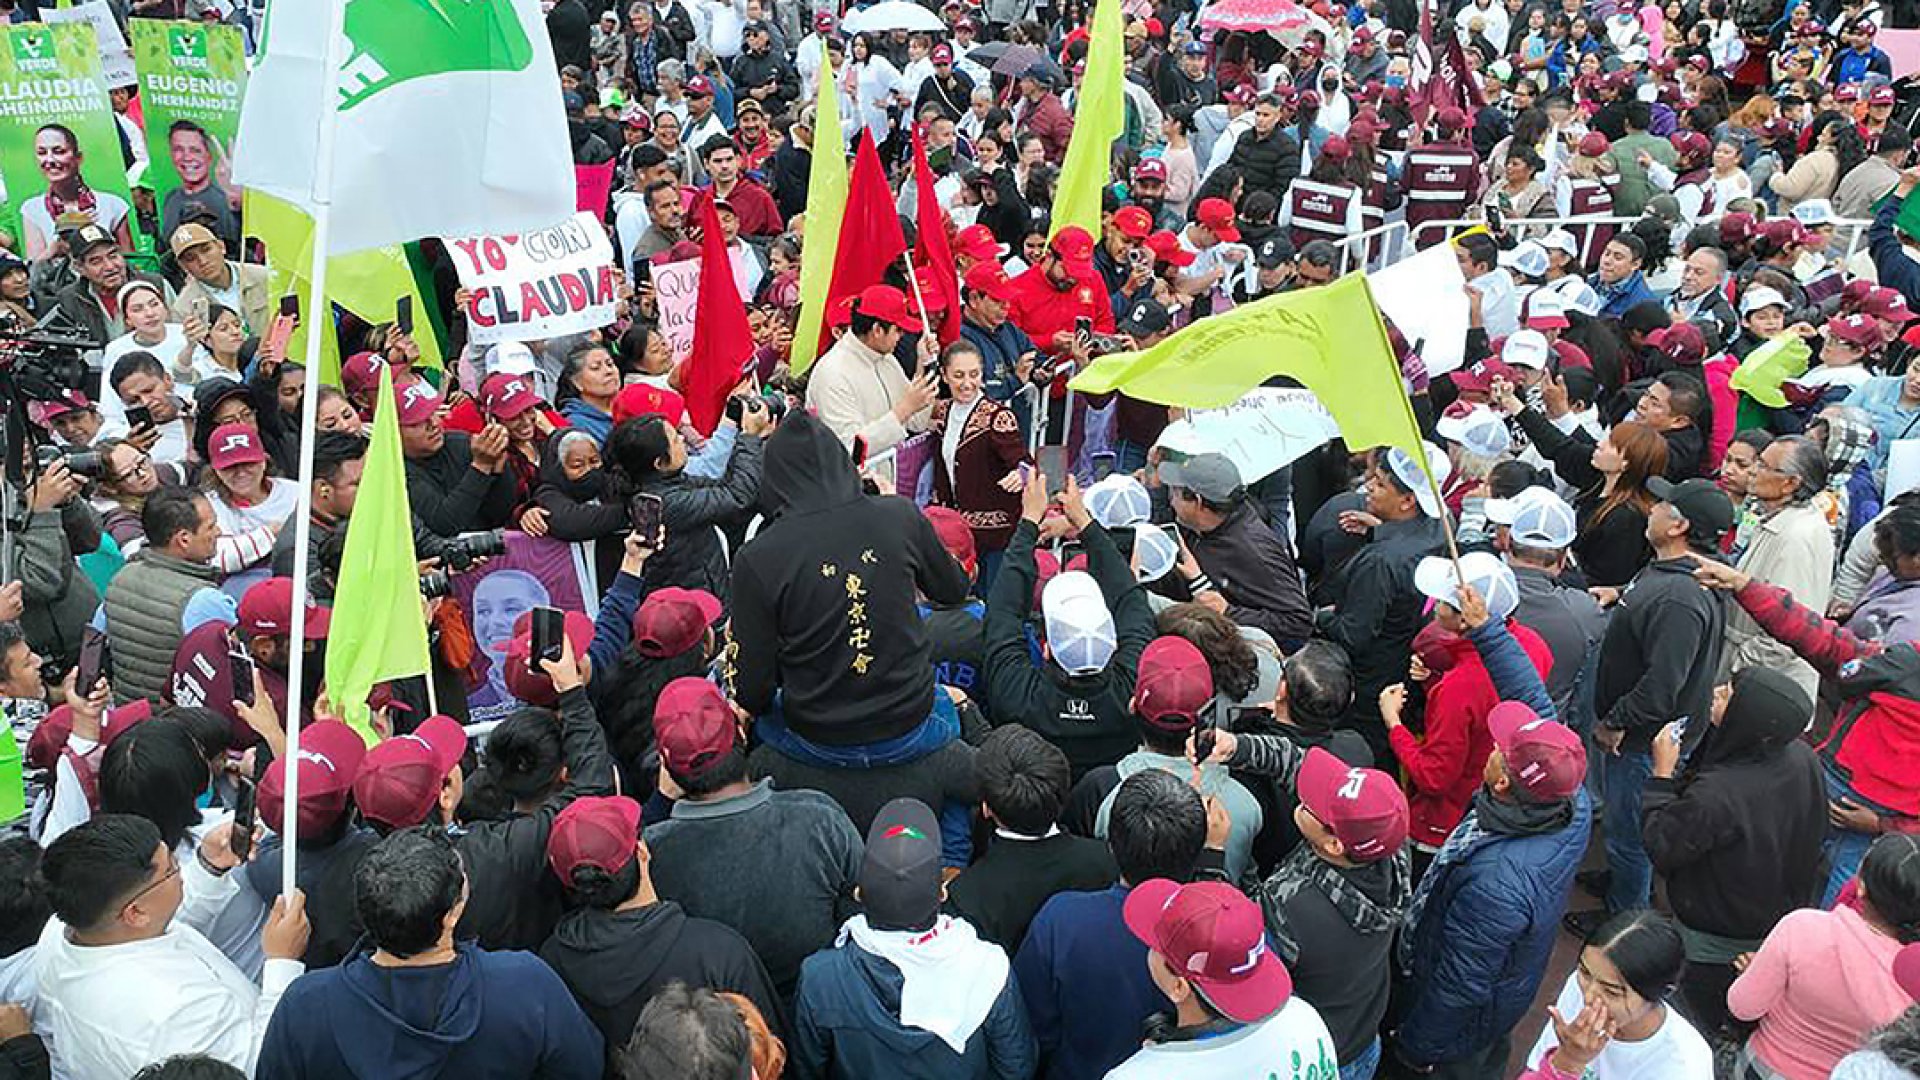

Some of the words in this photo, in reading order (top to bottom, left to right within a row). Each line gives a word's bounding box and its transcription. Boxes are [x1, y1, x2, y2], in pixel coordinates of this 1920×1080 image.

[0, 78, 99, 101] LAUDIA
[147, 74, 238, 97] EUGENIO
[455, 237, 507, 275] YO
[523, 217, 592, 263] CON
[468, 265, 614, 327] CLAUDIA
